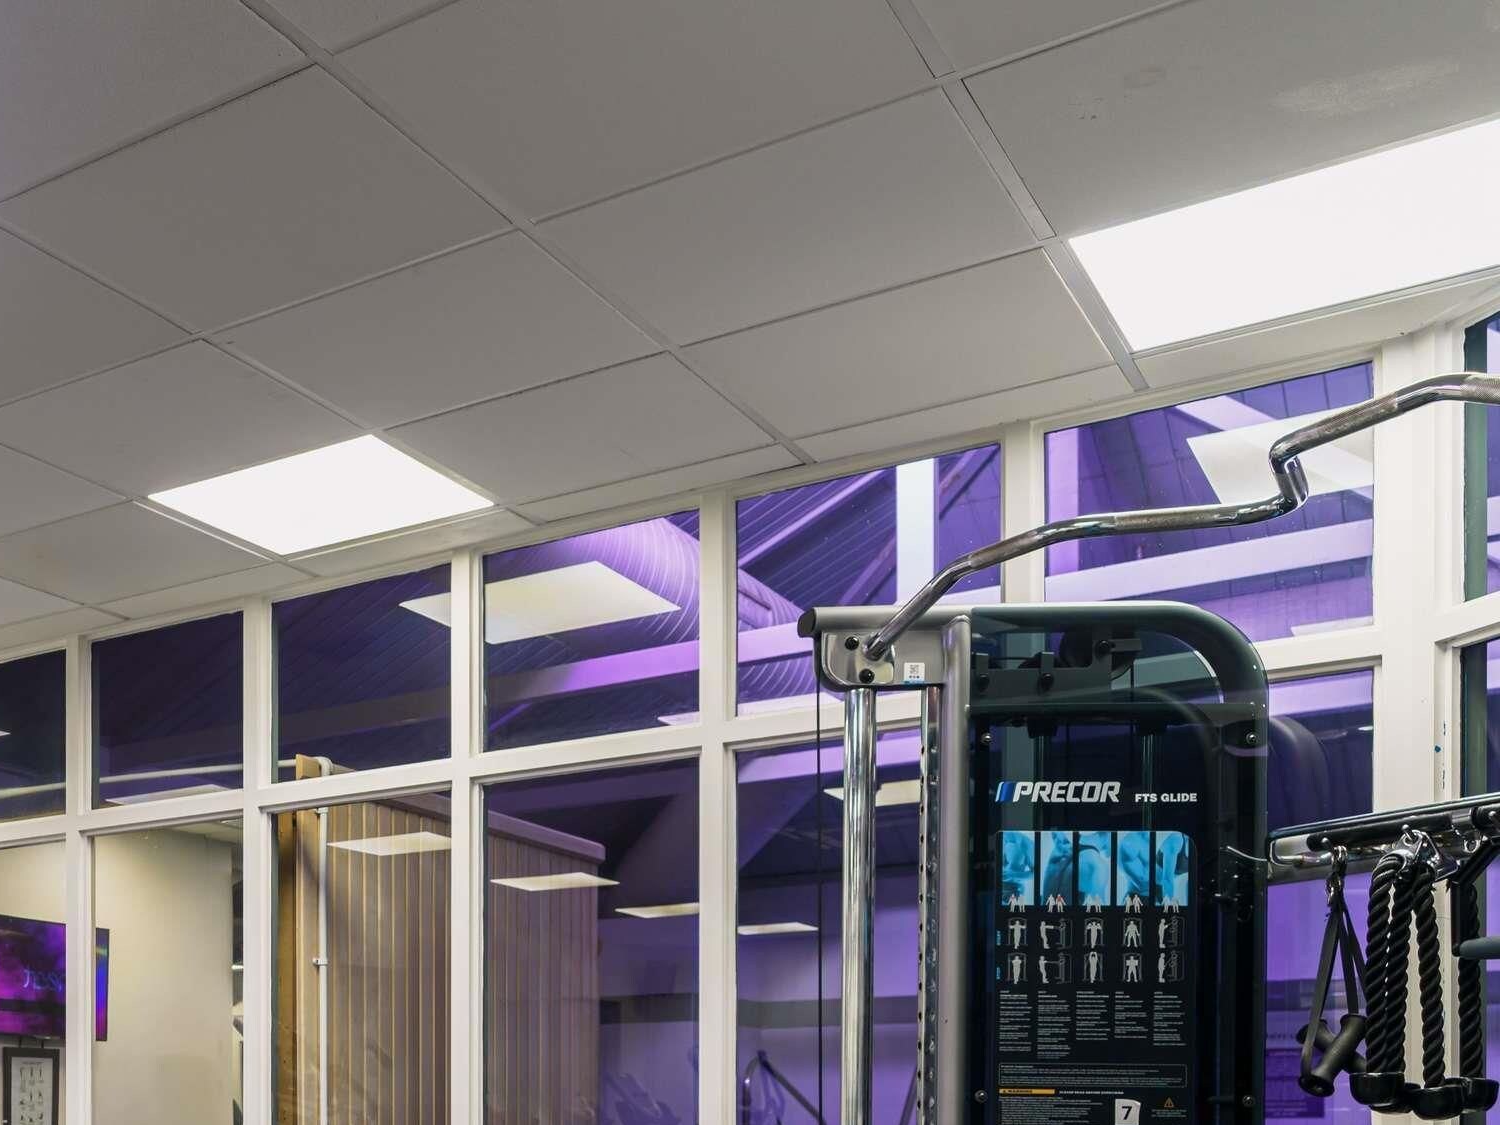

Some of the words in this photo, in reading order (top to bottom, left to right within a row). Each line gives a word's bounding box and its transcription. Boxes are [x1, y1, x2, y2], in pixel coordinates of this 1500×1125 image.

[1013, 781, 1121, 803] PRECOR
[1134, 793, 1158, 803] FTS
[1160, 793, 1197, 802] GLIDE
[1121, 1105, 1133, 1120] 7
